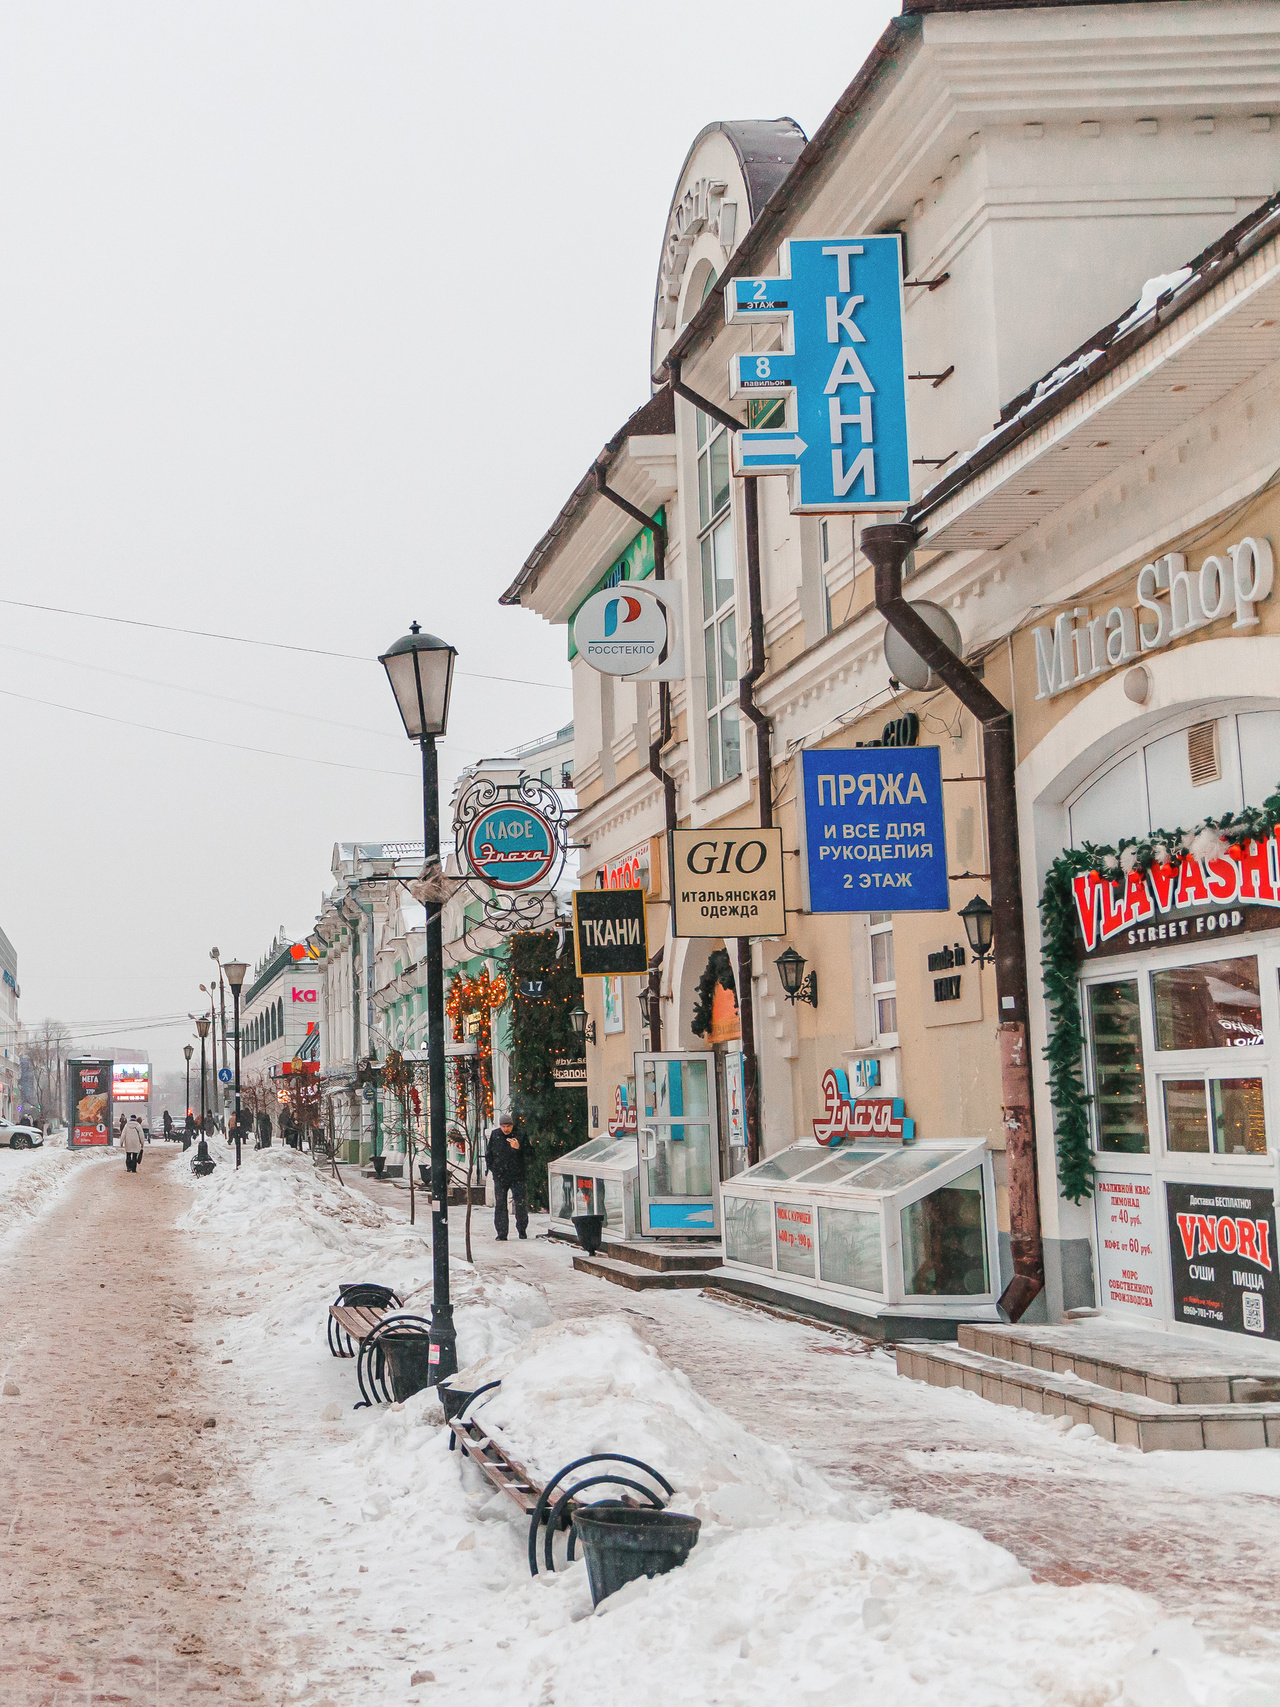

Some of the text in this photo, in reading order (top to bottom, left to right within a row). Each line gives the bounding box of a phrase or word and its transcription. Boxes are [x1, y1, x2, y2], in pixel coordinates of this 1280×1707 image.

[752, 280, 767, 300] 2
[746, 300, 775, 309] ЭТАЖ
[755, 357, 771, 379] 8
[821, 244, 876, 497] ТКАНИ
[743, 379, 786, 387] павильон
[588, 645, 655, 655] РОССТЕКЛО
[817, 772, 928, 807] ПРЯЖА
[485, 820, 534, 840] КАФЕ
[824, 822, 926, 840] И ВСЕ ДЛЯ
[474, 843, 550, 866] Эпоха
[686, 840, 767, 875] GIO
[819, 843, 934, 862] РУКОДЕЛИЯ
[843, 872, 913, 889] 2 ЭТАЖ
[681, 889, 777, 903] итальянская
[1071, 834, 1280, 952] VLAVASH
[700, 904, 759, 919] одежда
[581, 918, 641, 946] ТКАНИ
[1128, 910, 1243, 945] STREET FOOD
[528, 981, 543, 992] 17
[1098, 1183, 1151, 1195] РАЗЛИВНОЙ КВАС
[1118, 1209, 1129, 1224] 40
[1104, 1239, 1120, 1250] КОФЕ
[1129, 1238, 1139, 1253] 60
[1176, 1212, 1273, 1272] VNORI
[1121, 1269, 1139, 1280] МОРС
[1189, 1264, 1215, 1282] СУШИ
[1232, 1270, 1265, 1291] ПИЦЦА
